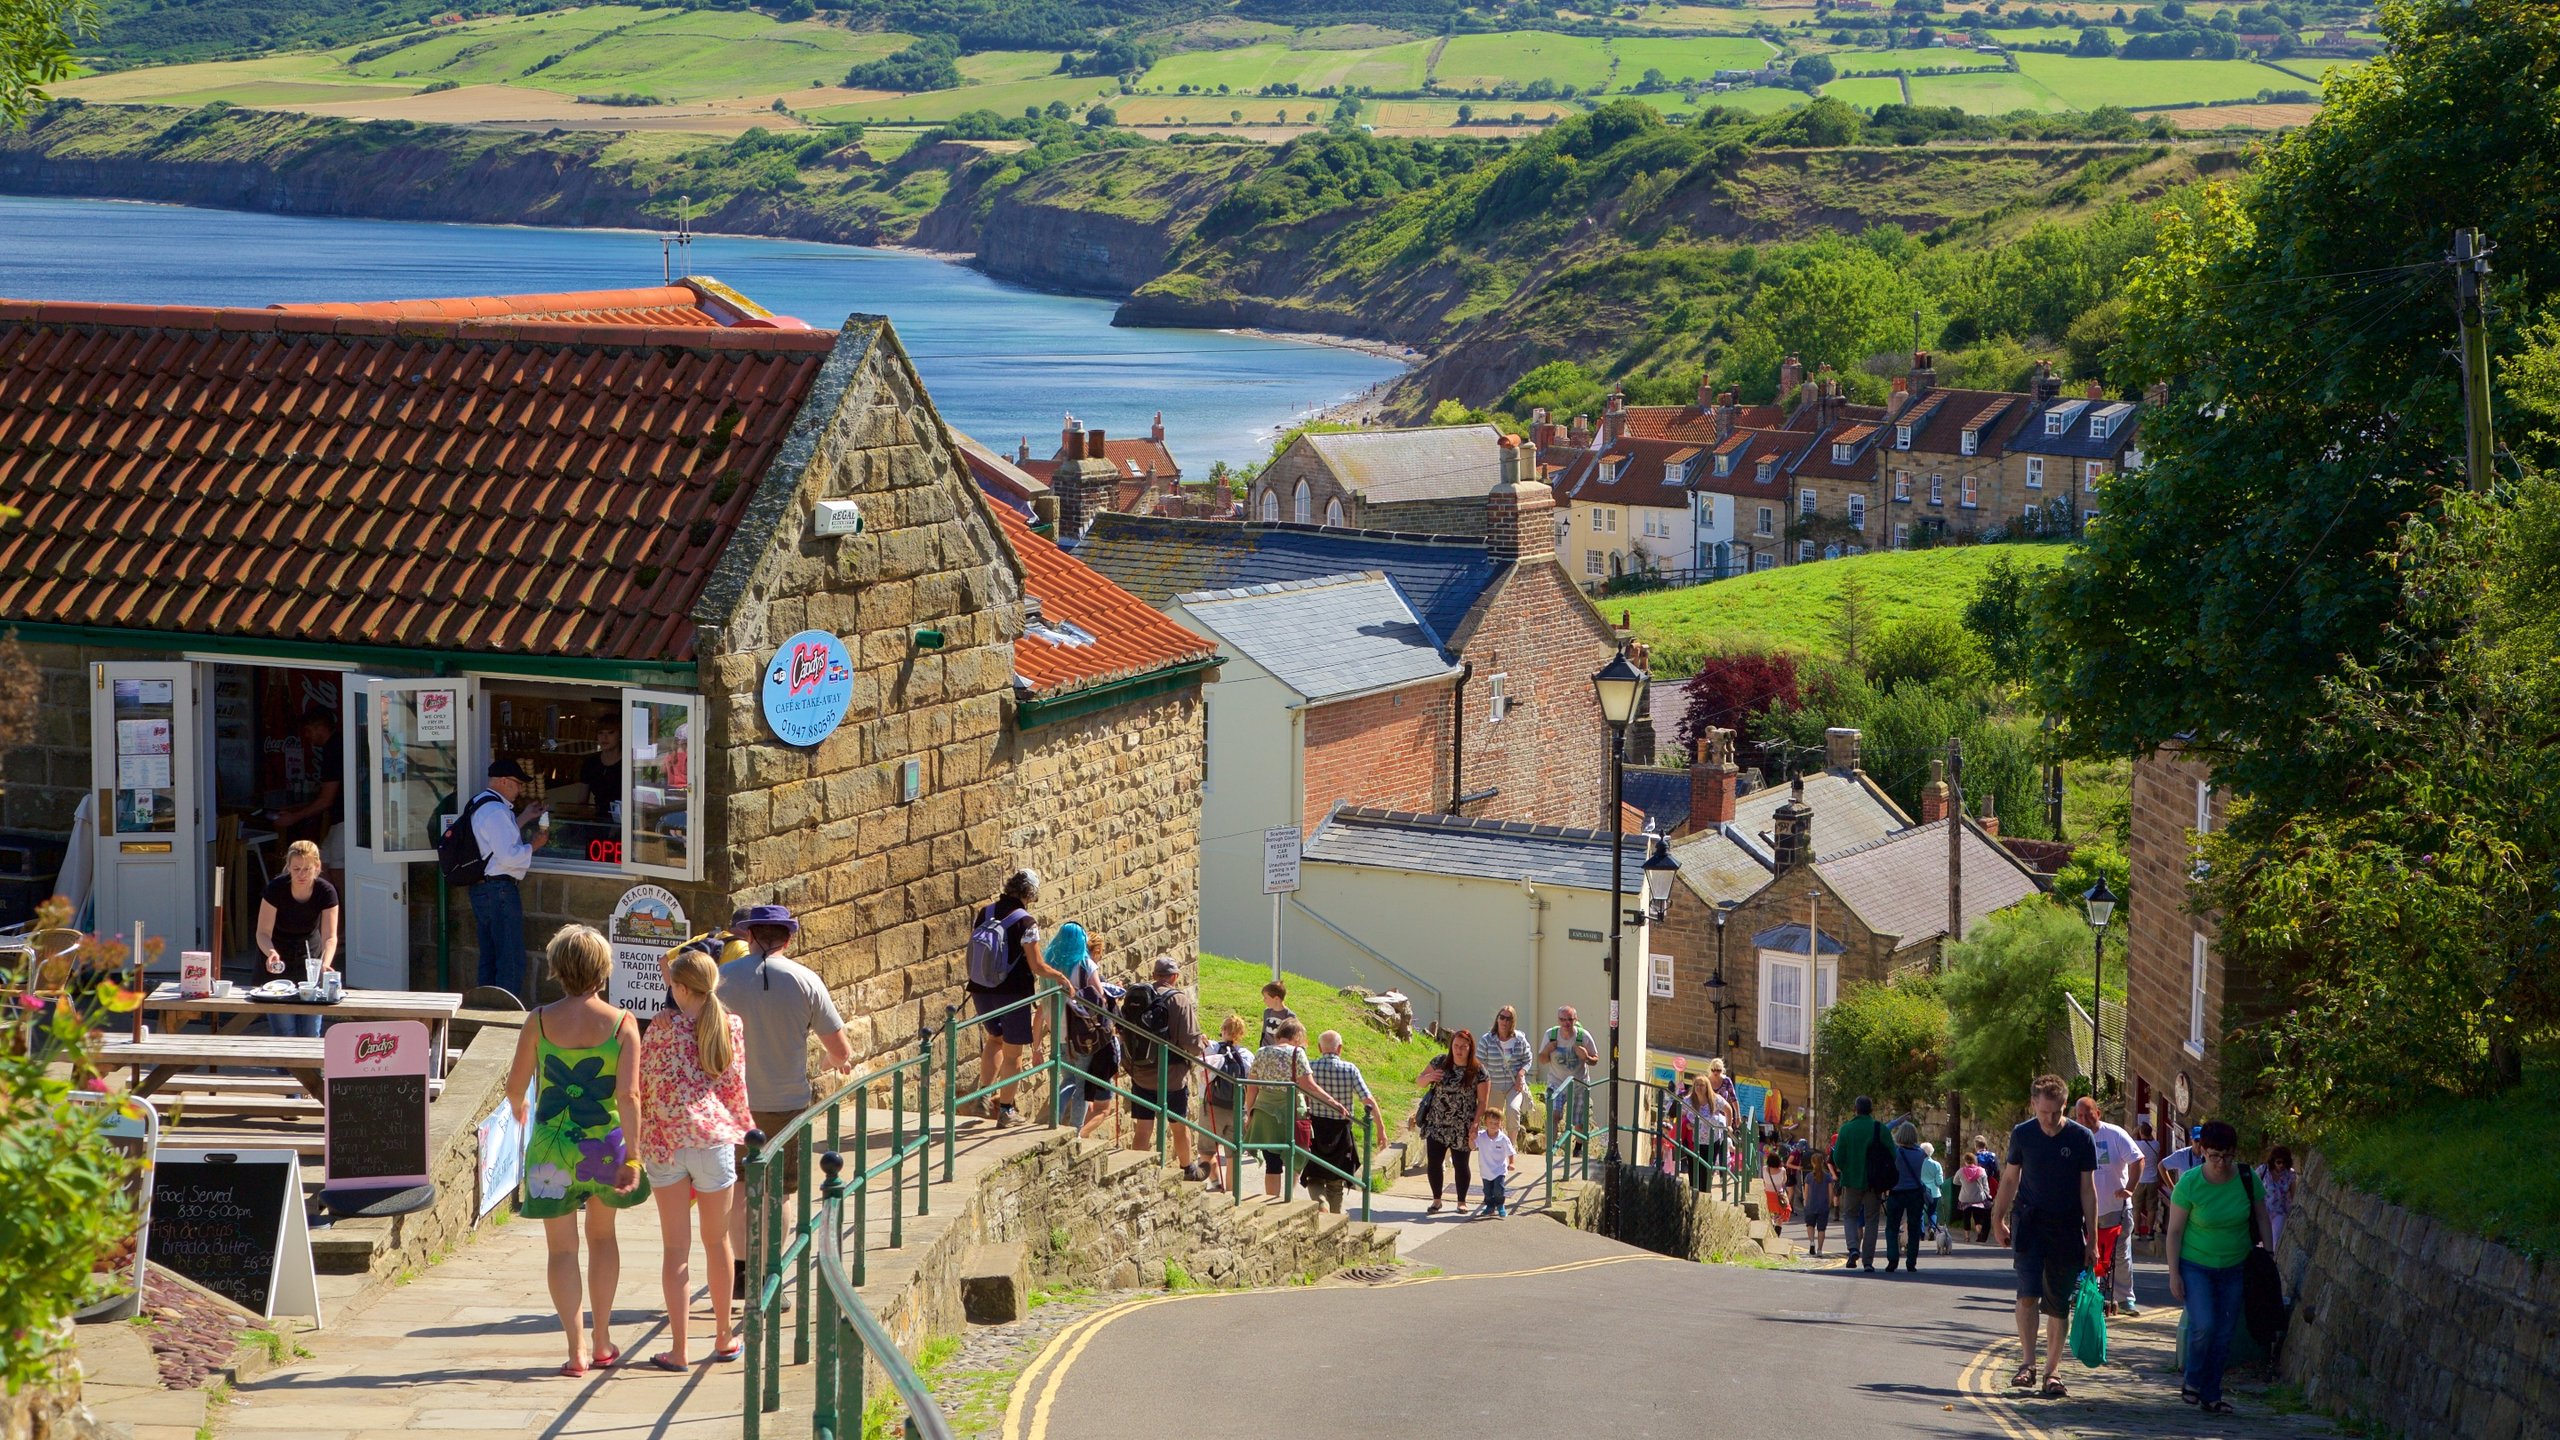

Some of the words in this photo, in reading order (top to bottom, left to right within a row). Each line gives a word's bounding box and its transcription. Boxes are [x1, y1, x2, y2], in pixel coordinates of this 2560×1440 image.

[832, 510, 855, 520] REGAL
[775, 700, 794, 714] CAFÉ
[795, 702, 801, 710] &
[802, 693, 842, 709] TAKE-AWAY
[781, 719, 806, 739] 01947
[808, 709, 836, 738] 880595
[590, 840, 622, 864] OPE
[1271, 842, 1295, 850] RESERVED
[622, 887, 654, 907] BEACON
[656, 889, 679, 910] FARM
[613, 935, 644, 944] TRADITIONAL
[620, 952, 654, 962] BEACON
[622, 961, 661, 972] TRADITIO
[637, 972, 663, 982] DAIRY
[627, 981, 668, 991] ICE-CREA
[620, 998, 646, 1011] sold
[651, 999, 666, 1012] he
[358, 1036, 395, 1059] Candys
[156, 1184, 185, 1203] Food
[189, 1184, 234, 1204] Served
[211, 1238, 252, 1256] Butter
